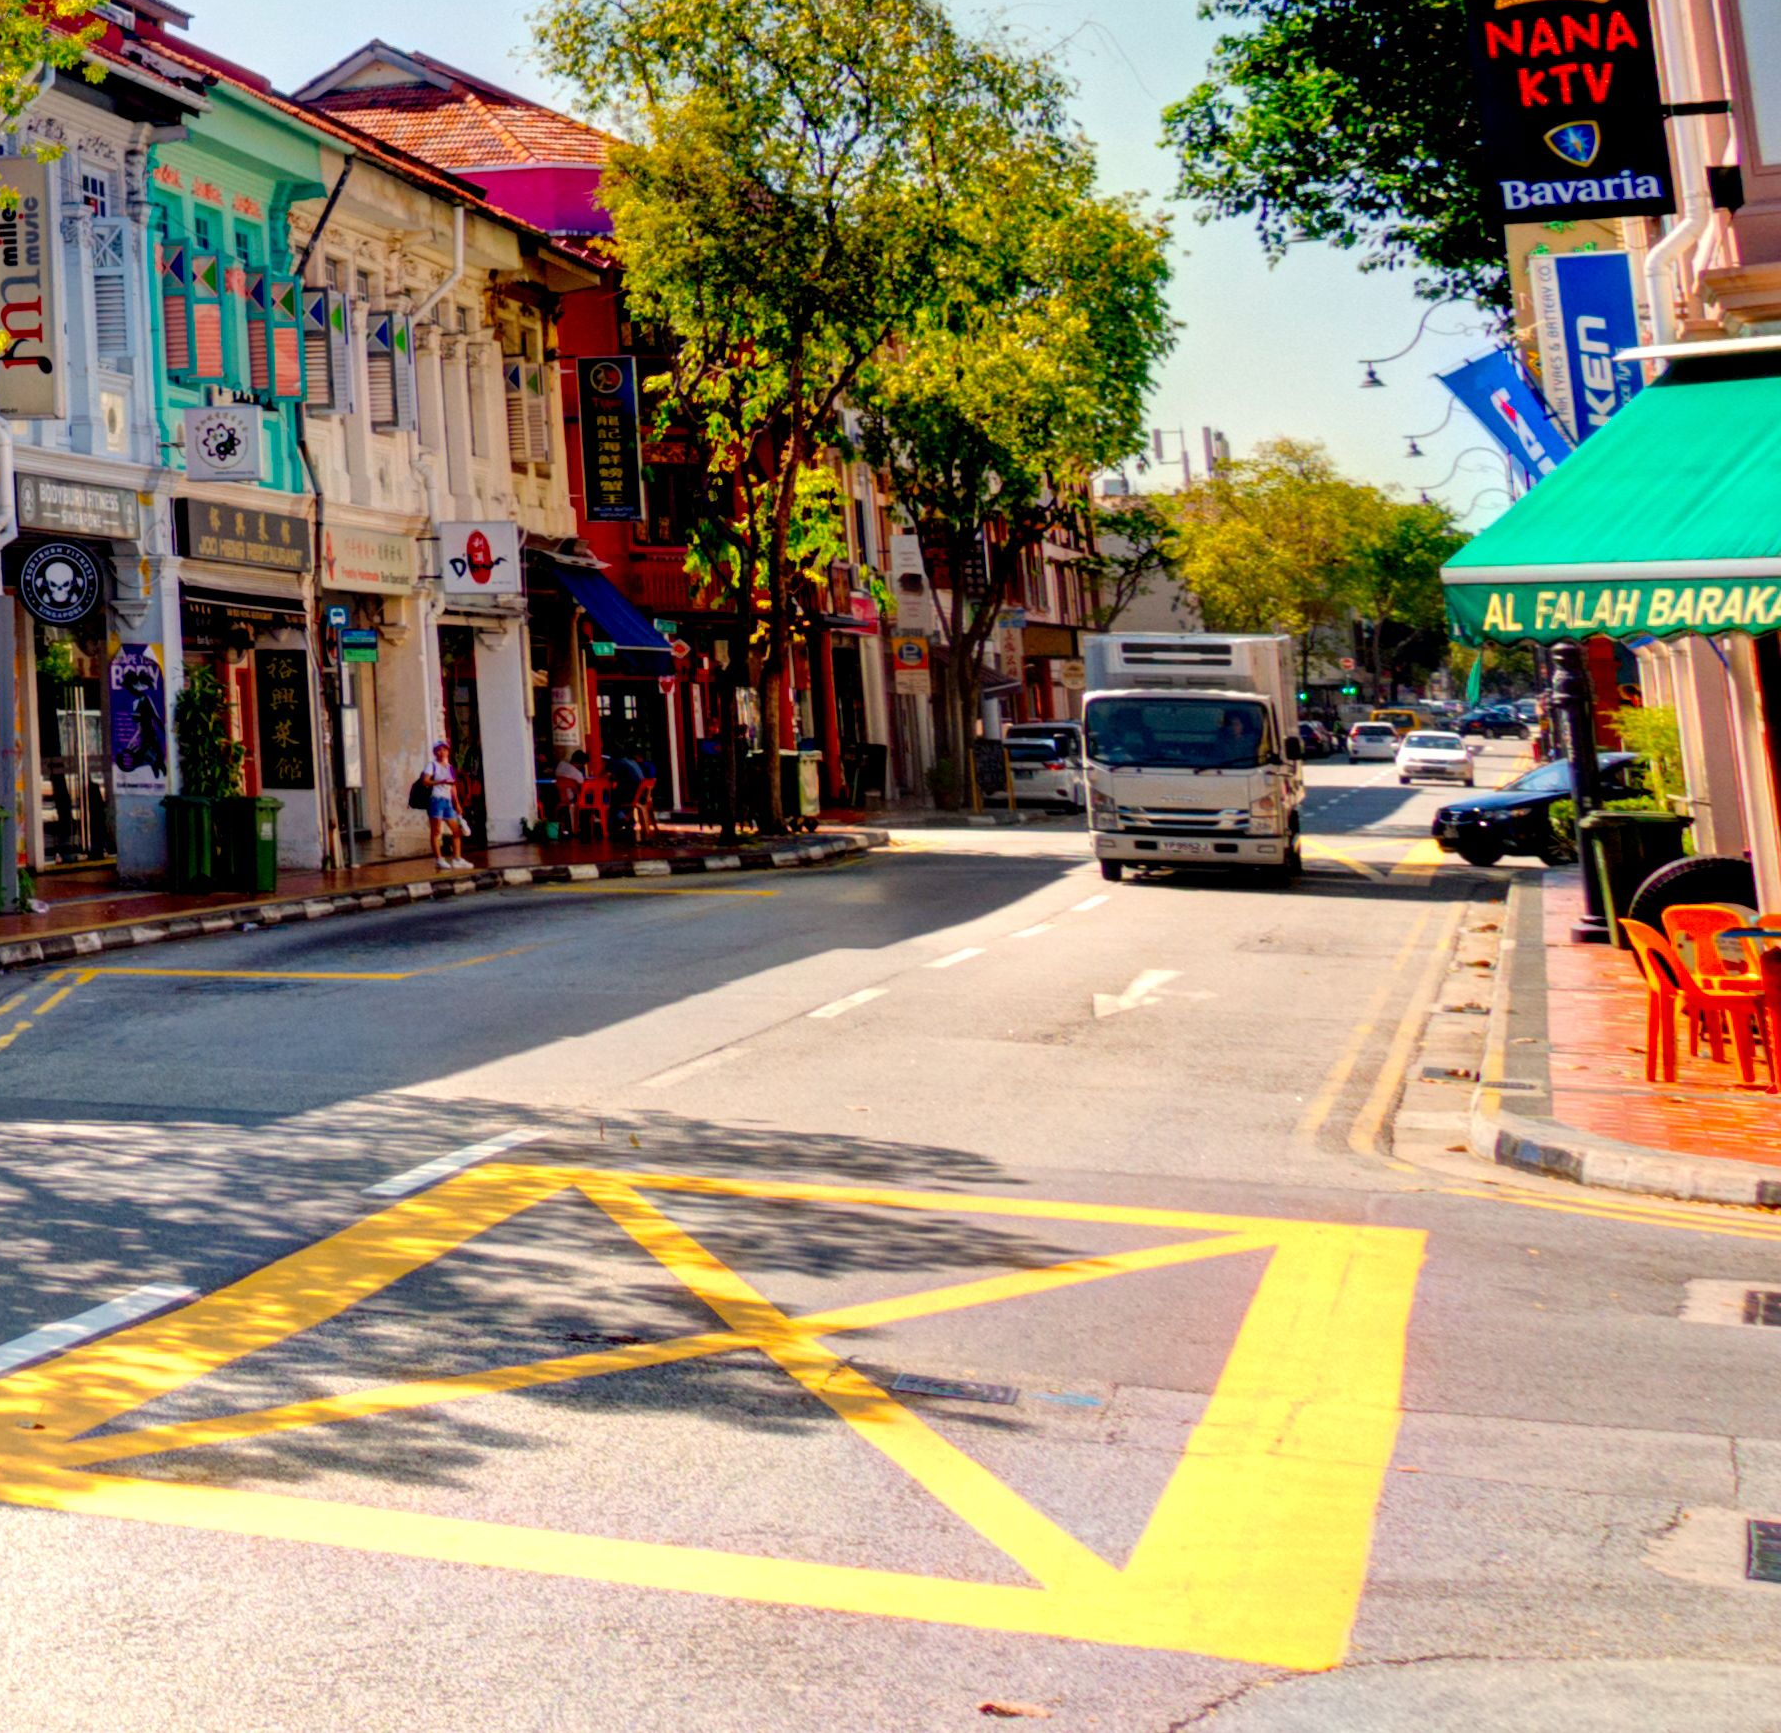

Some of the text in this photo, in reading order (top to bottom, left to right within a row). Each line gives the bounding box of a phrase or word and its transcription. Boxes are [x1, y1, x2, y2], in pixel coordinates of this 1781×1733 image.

[1484, 11, 1638, 59] NANA
[1517, 62, 1615, 108] KTV
[1499, 170, 1662, 212] Bavaria
[18, 196, 41, 266] music
[39, 483, 119, 512] BODYBURN FITNESS
[1483, 593, 1523, 631] AL
[1534, 589, 1641, 629] FALAH
